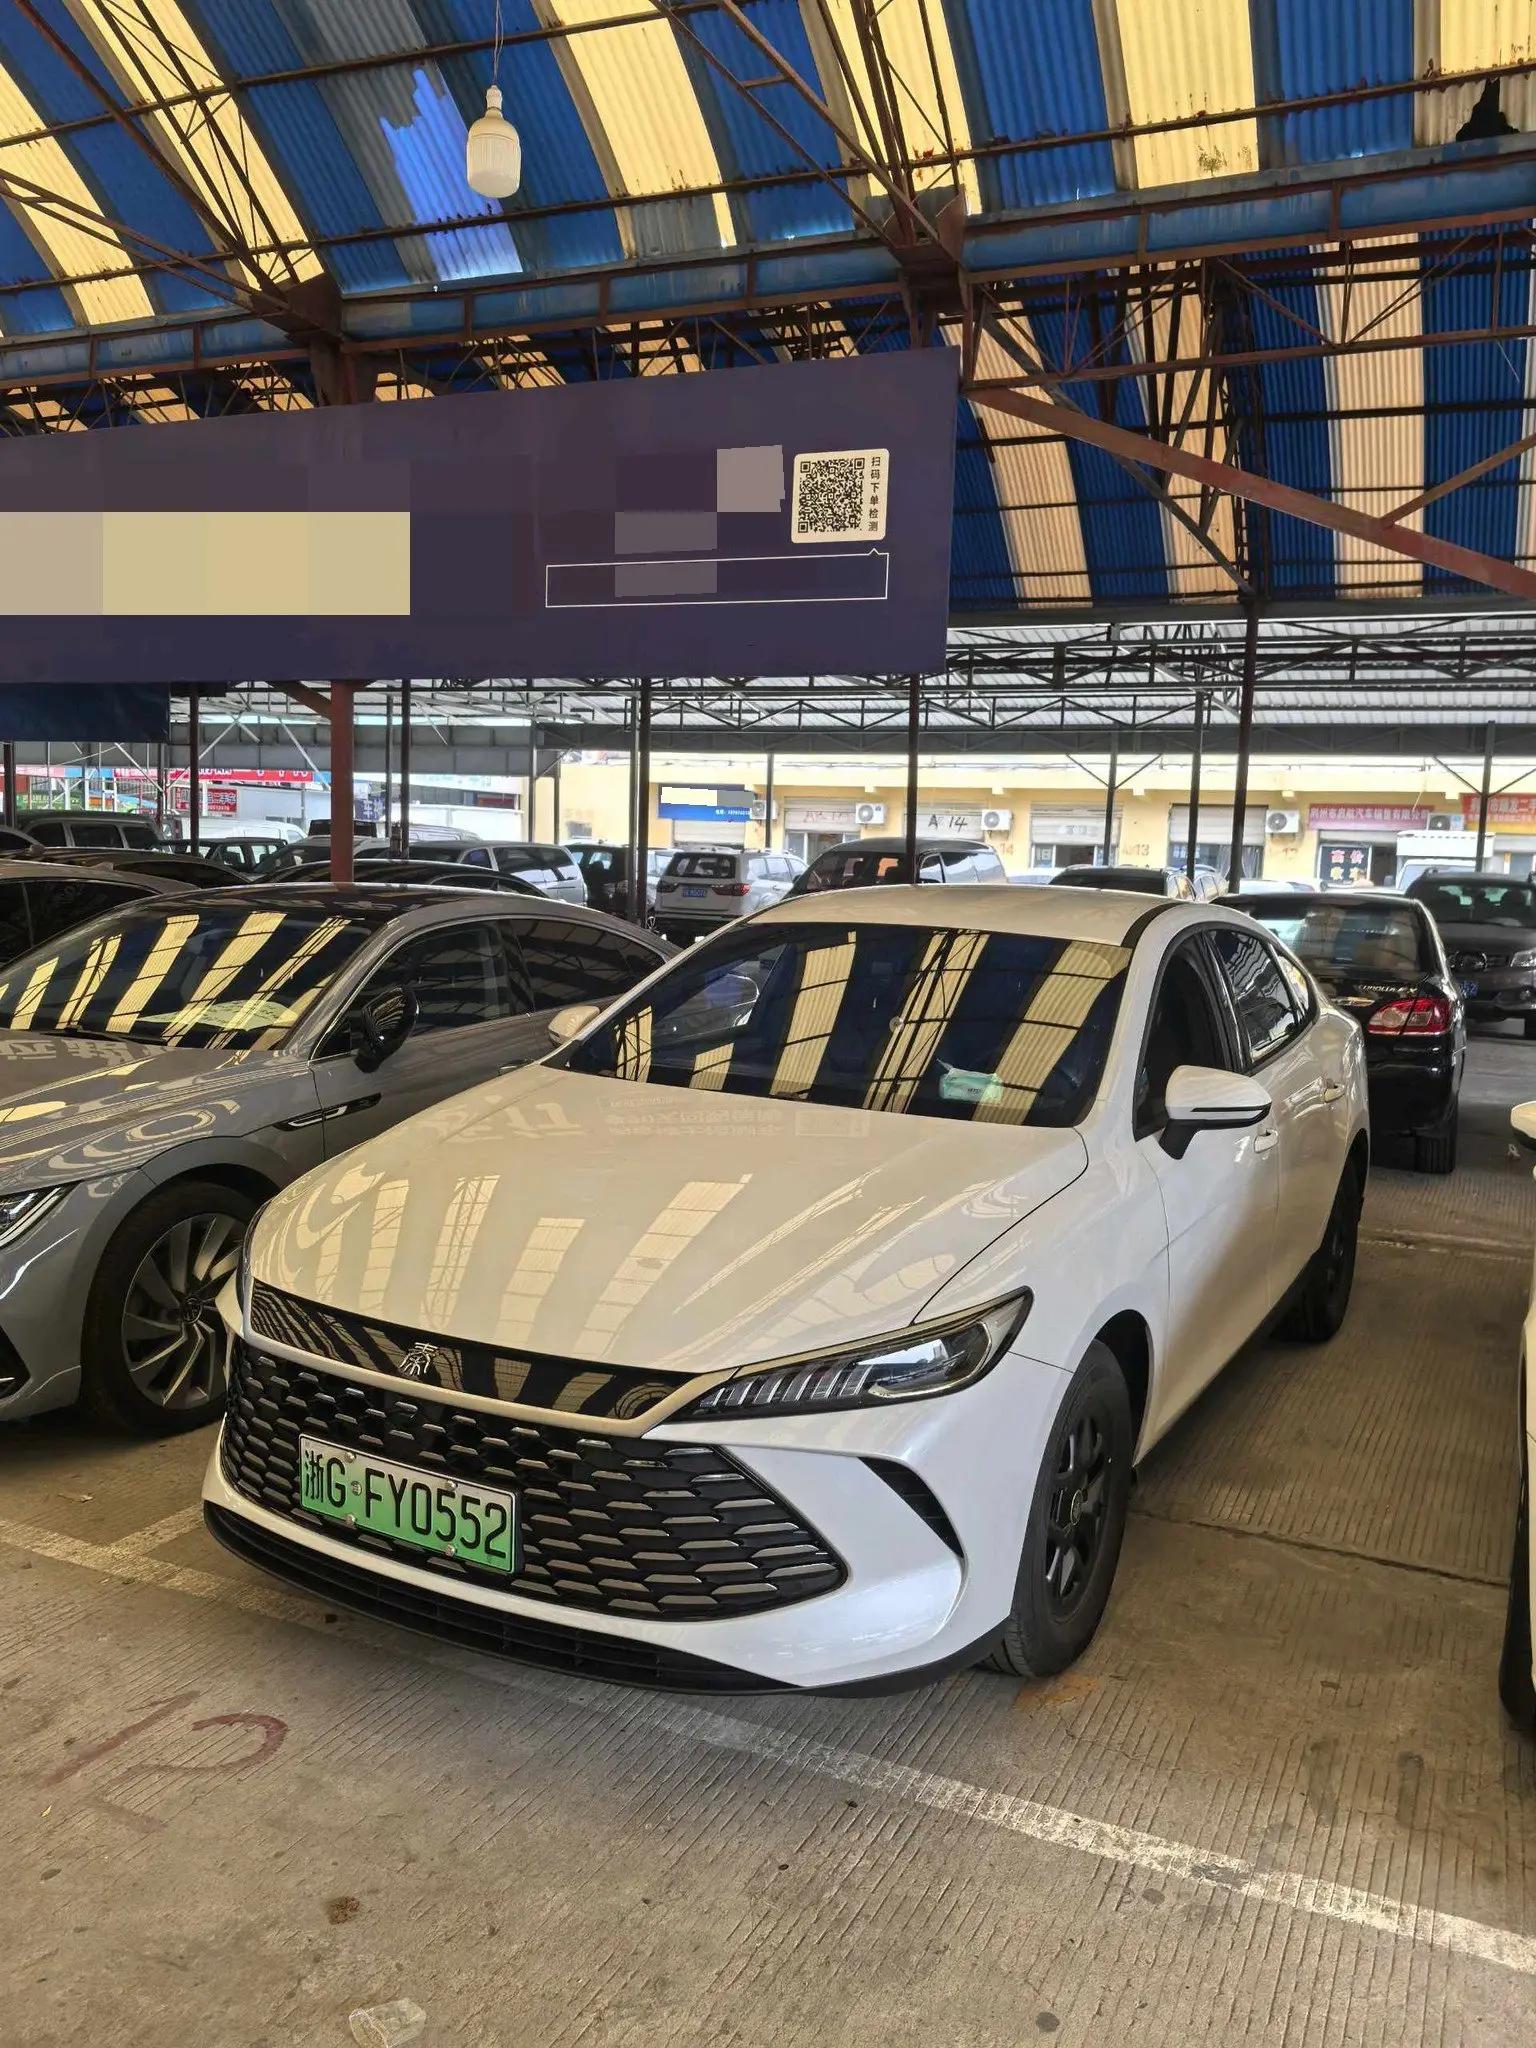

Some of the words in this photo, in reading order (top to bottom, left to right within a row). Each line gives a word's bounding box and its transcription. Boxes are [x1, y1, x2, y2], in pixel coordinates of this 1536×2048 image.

[868, 456, 881, 532] 扫码下单检测
